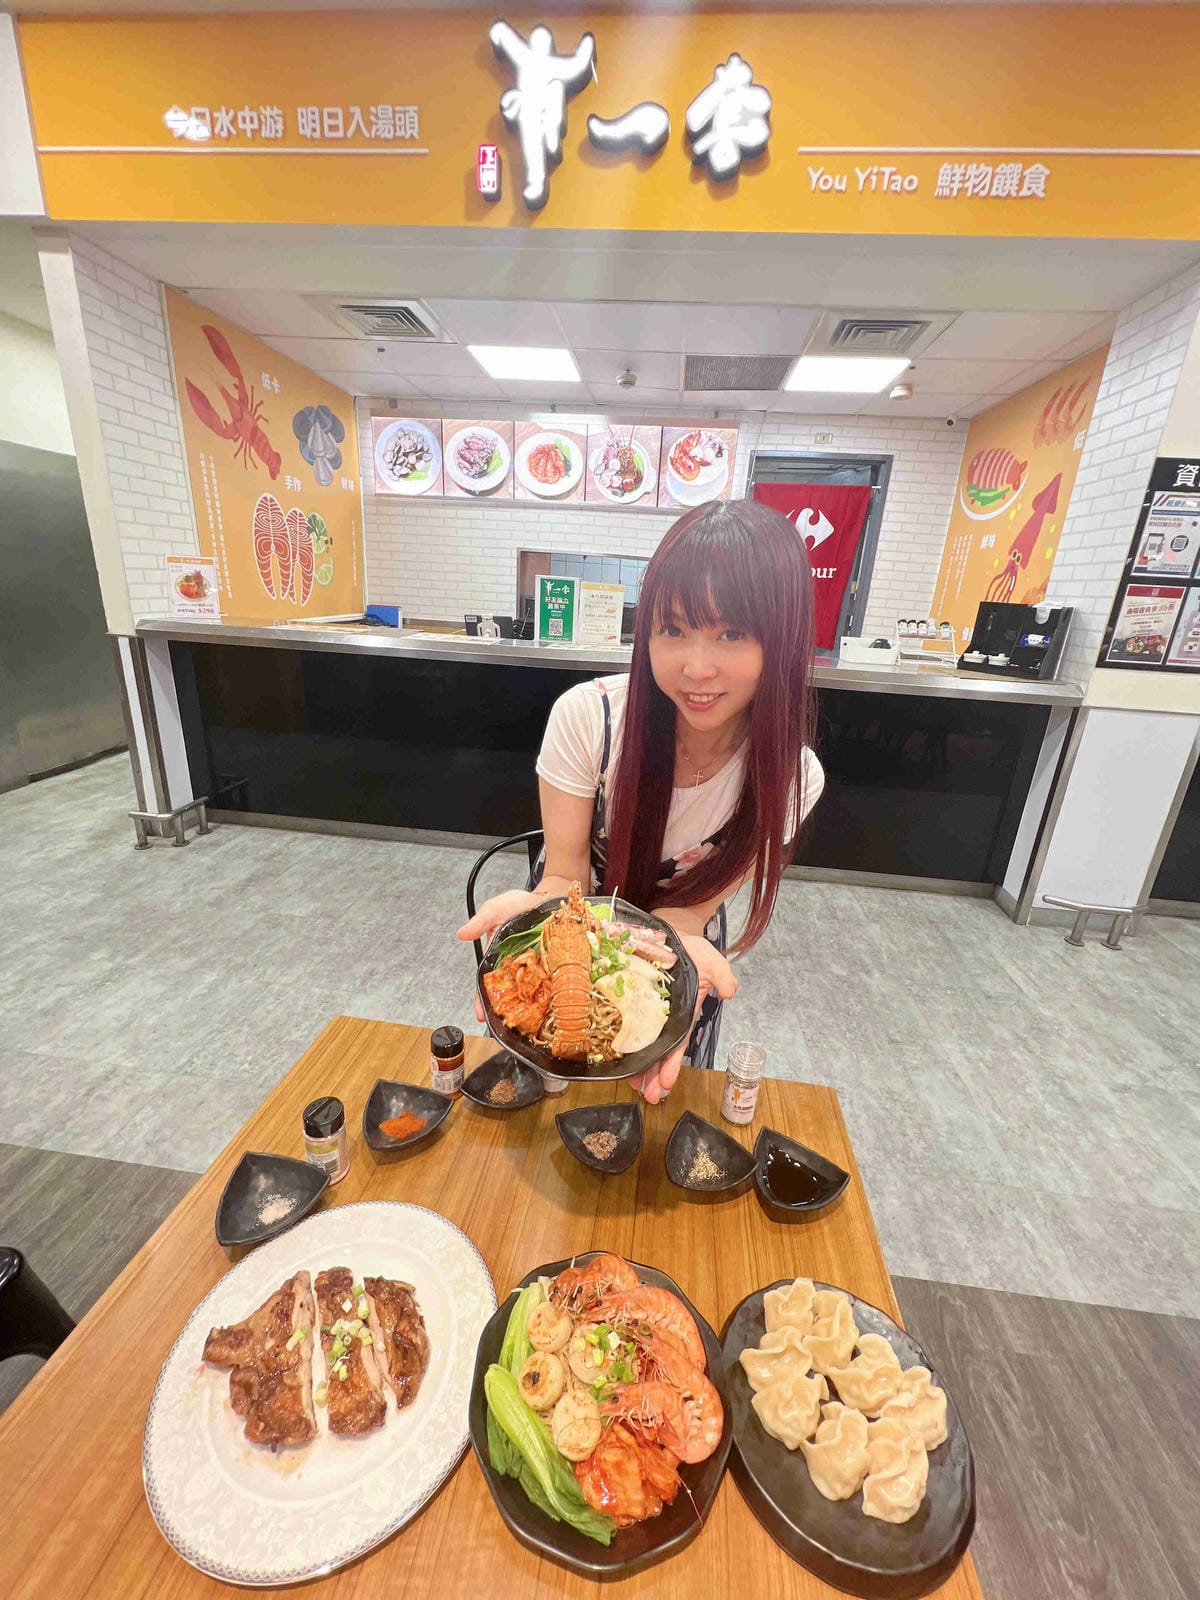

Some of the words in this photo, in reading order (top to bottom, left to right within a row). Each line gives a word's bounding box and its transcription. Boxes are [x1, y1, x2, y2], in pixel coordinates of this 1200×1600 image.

[297, 104, 419, 139] 明日入湯頭
[807, 165, 847, 192] You
[854, 165, 919, 192] YiTao
[934, 162, 1050, 197] 鮮物饌食
[1173, 463, 1200, 487] 資
